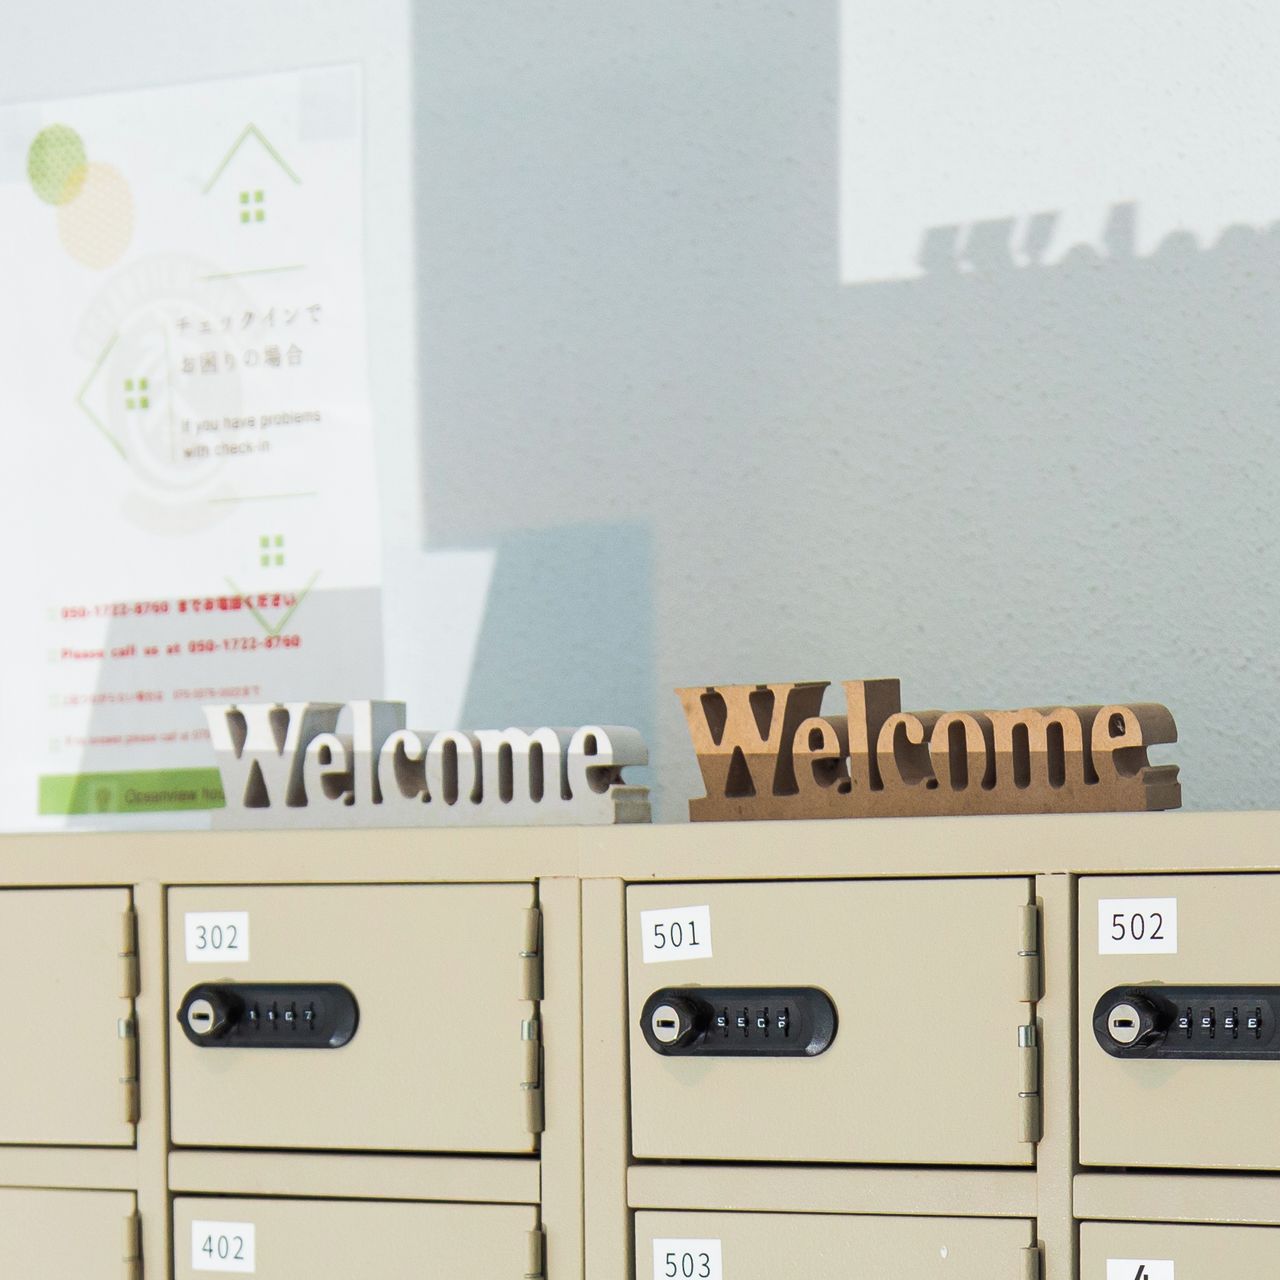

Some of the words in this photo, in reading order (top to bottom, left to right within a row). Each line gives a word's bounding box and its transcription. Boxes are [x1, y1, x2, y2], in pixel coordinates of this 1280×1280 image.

[195, 419, 219, 436] you
[223, 415, 257, 430] have
[260, 411, 321, 430] problems
[183, 443, 210, 459] with
[214, 440, 271, 457] check-in
[111, 643, 136, 658] call
[676, 678, 1155, 804] Welcome
[204, 698, 625, 812] Welcome
[195, 924, 239, 950] 302
[653, 920, 700, 950] 501
[1111, 912, 1165, 941] 502
[201, 1234, 244, 1260] 402
[665, 1252, 711, 1279] 503
